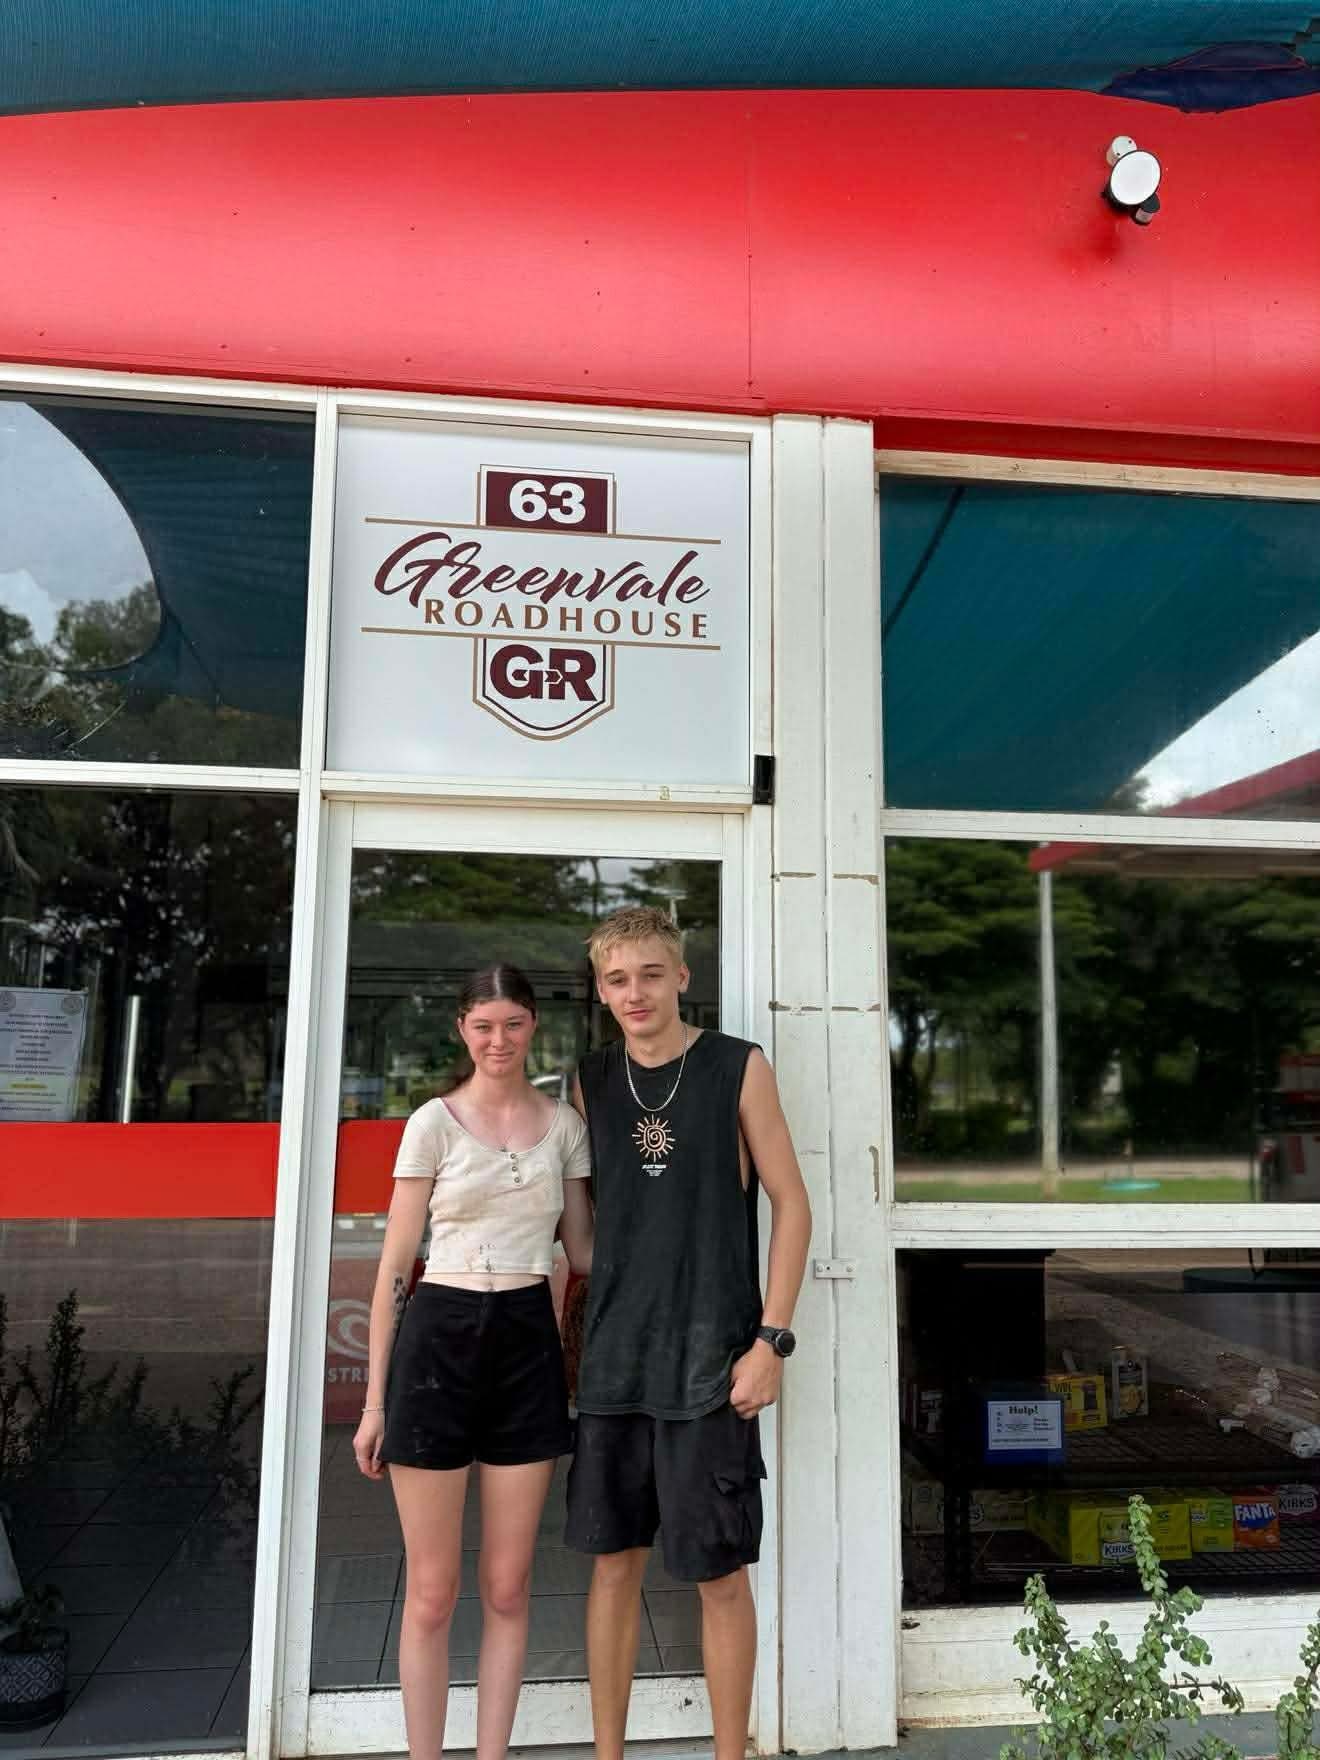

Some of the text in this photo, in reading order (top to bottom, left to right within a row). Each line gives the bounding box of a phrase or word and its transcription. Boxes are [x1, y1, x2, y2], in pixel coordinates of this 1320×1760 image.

[509, 479, 586, 524] 63
[374, 531, 711, 608] Greenvale
[424, 598, 708, 639] ROADHOUSE
[489, 644, 597, 702] GR
[1009, 1405, 1039, 1416] Help!
[1234, 1503, 1276, 1520] FANTA
[1279, 1496, 1313, 1512] KIRKS
[1104, 1544, 1134, 1555] KIRKS
